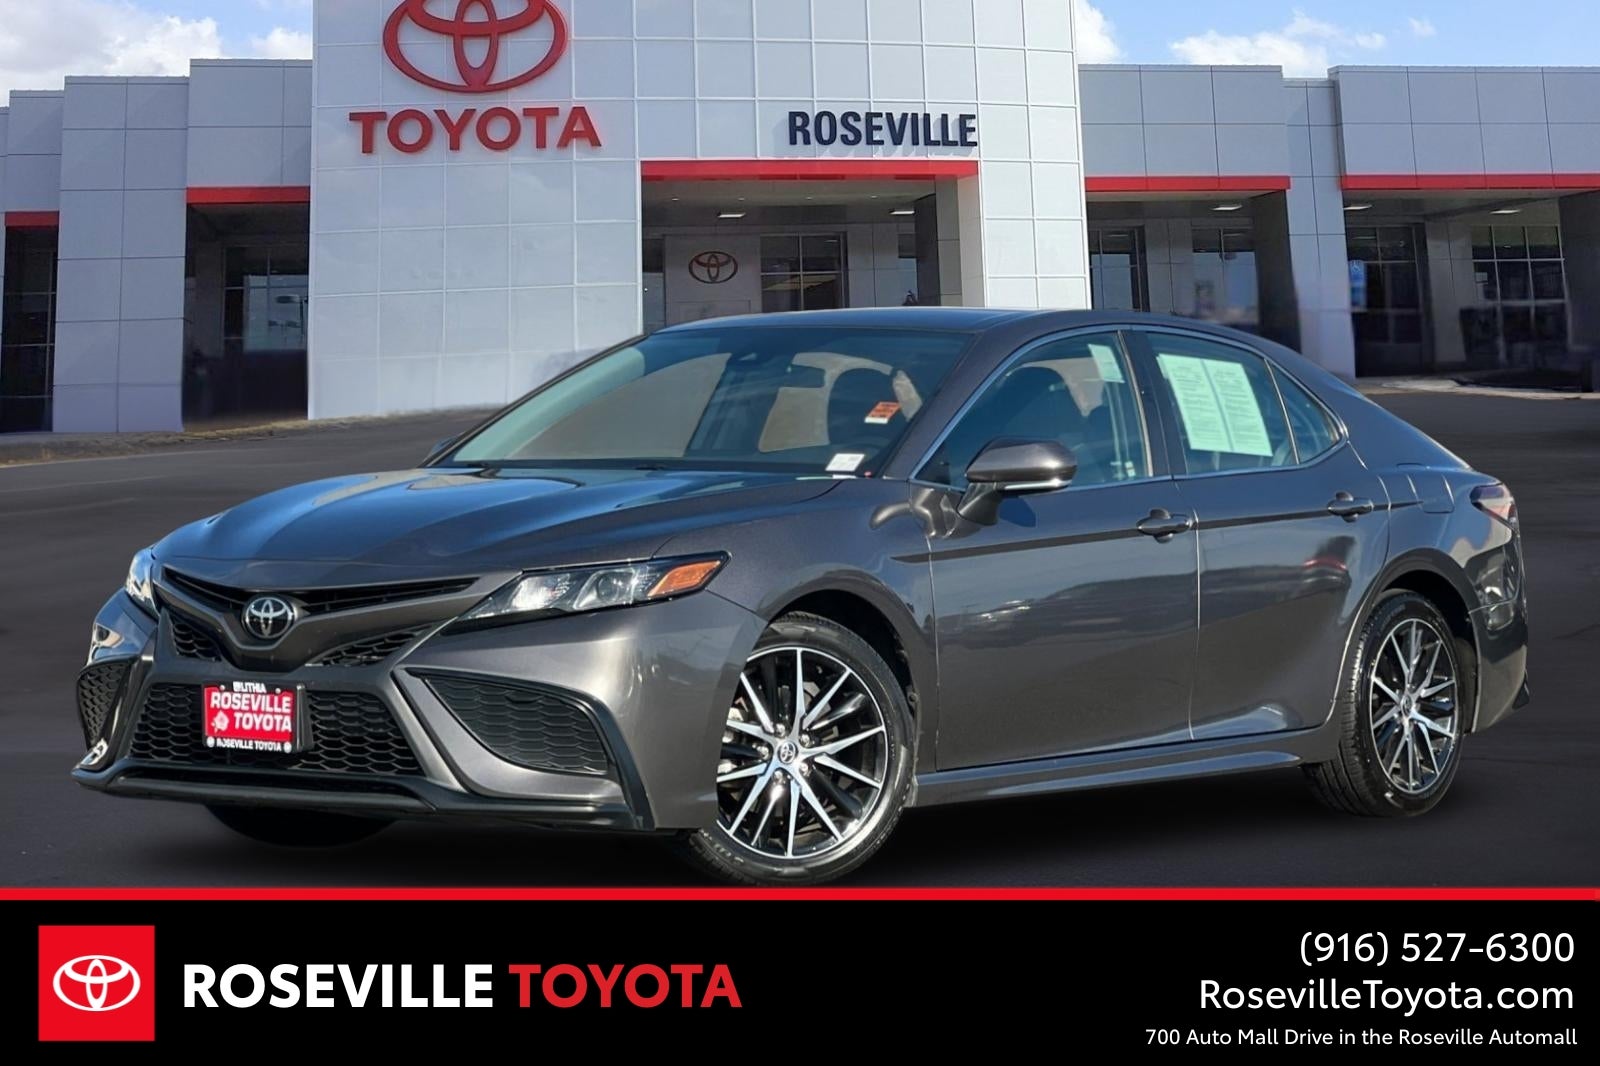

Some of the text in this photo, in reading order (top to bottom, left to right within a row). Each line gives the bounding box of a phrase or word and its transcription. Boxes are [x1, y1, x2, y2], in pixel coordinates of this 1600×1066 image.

[349, 106, 602, 154] TOYOTA
[788, 110, 979, 147] ROSEVILLE
[210, 691, 292, 713] ROSEVILLE
[233, 711, 293, 732] TOYOTA
[216, 737, 282, 752] ROSEVILLE TOYOTA
